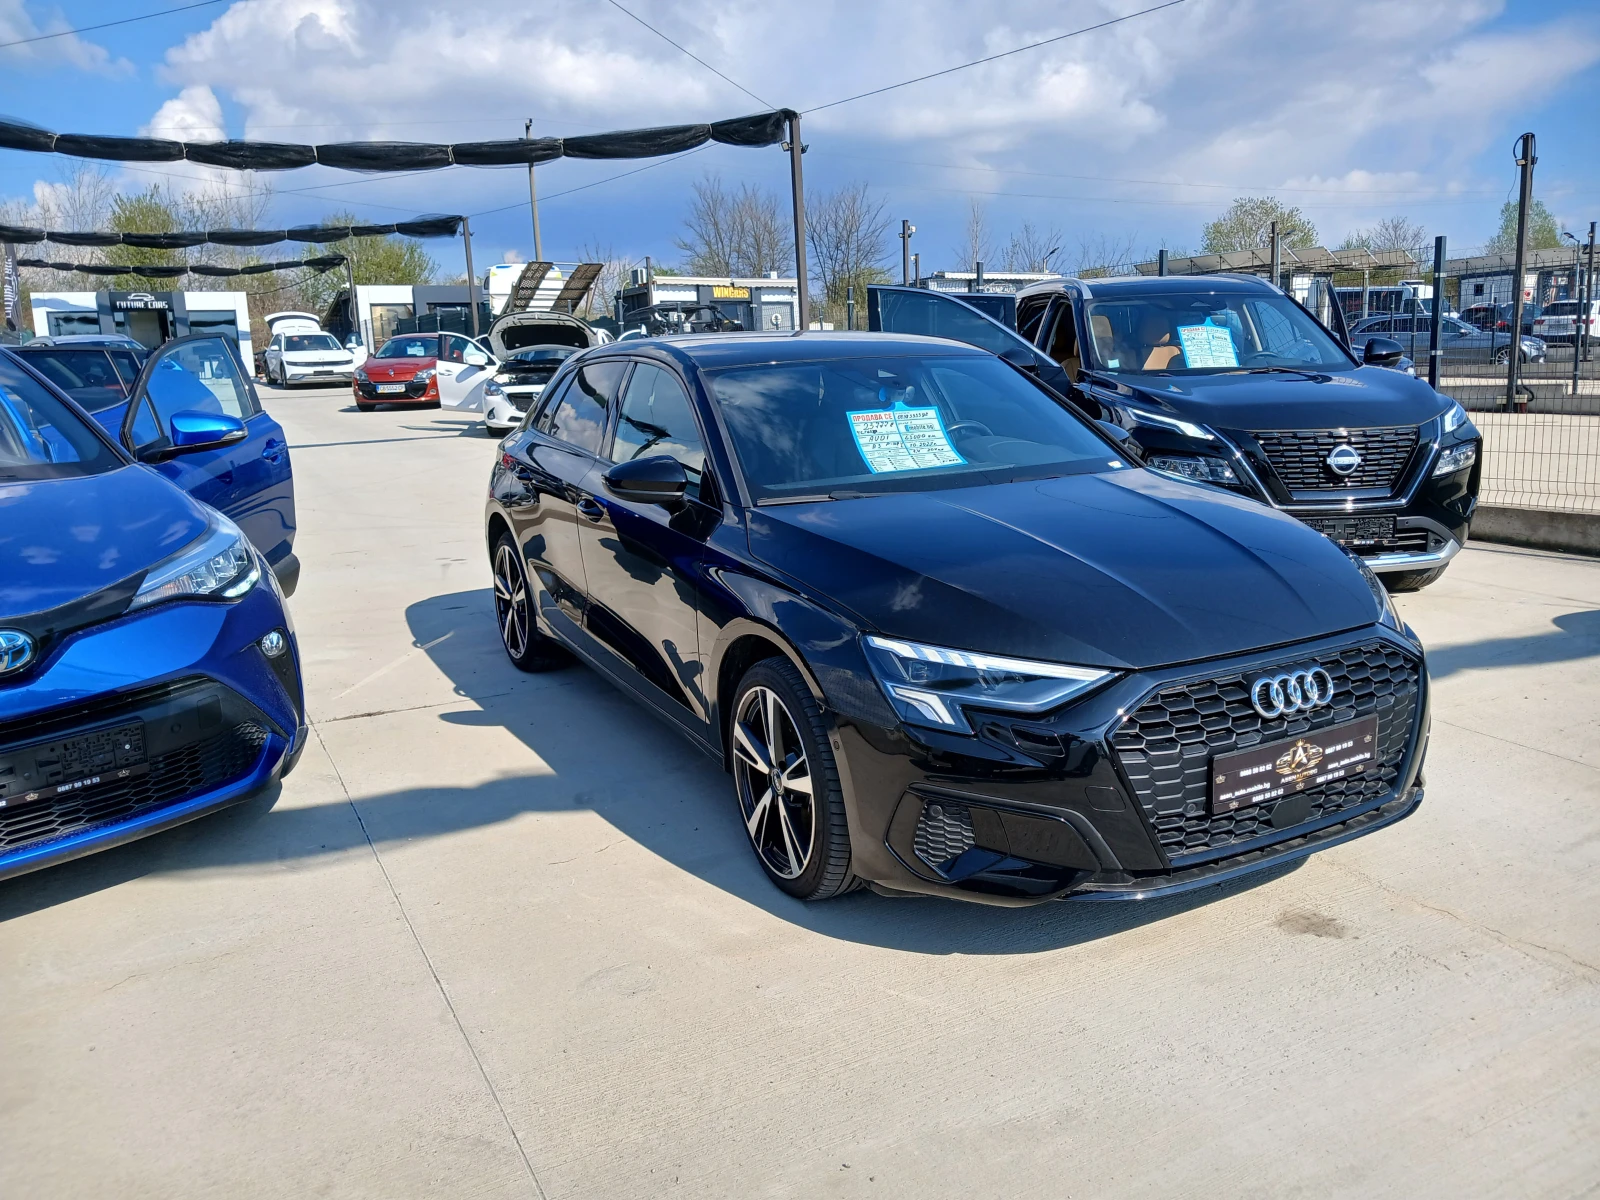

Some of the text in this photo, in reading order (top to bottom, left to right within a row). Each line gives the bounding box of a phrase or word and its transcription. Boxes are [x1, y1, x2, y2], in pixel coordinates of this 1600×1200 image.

[713, 286, 749, 298] WINCARS
[116, 300, 169, 309] FUTURE CARS
[852, 414, 883, 422] ПРОДАВА
[57, 784, 72, 793] 0887
